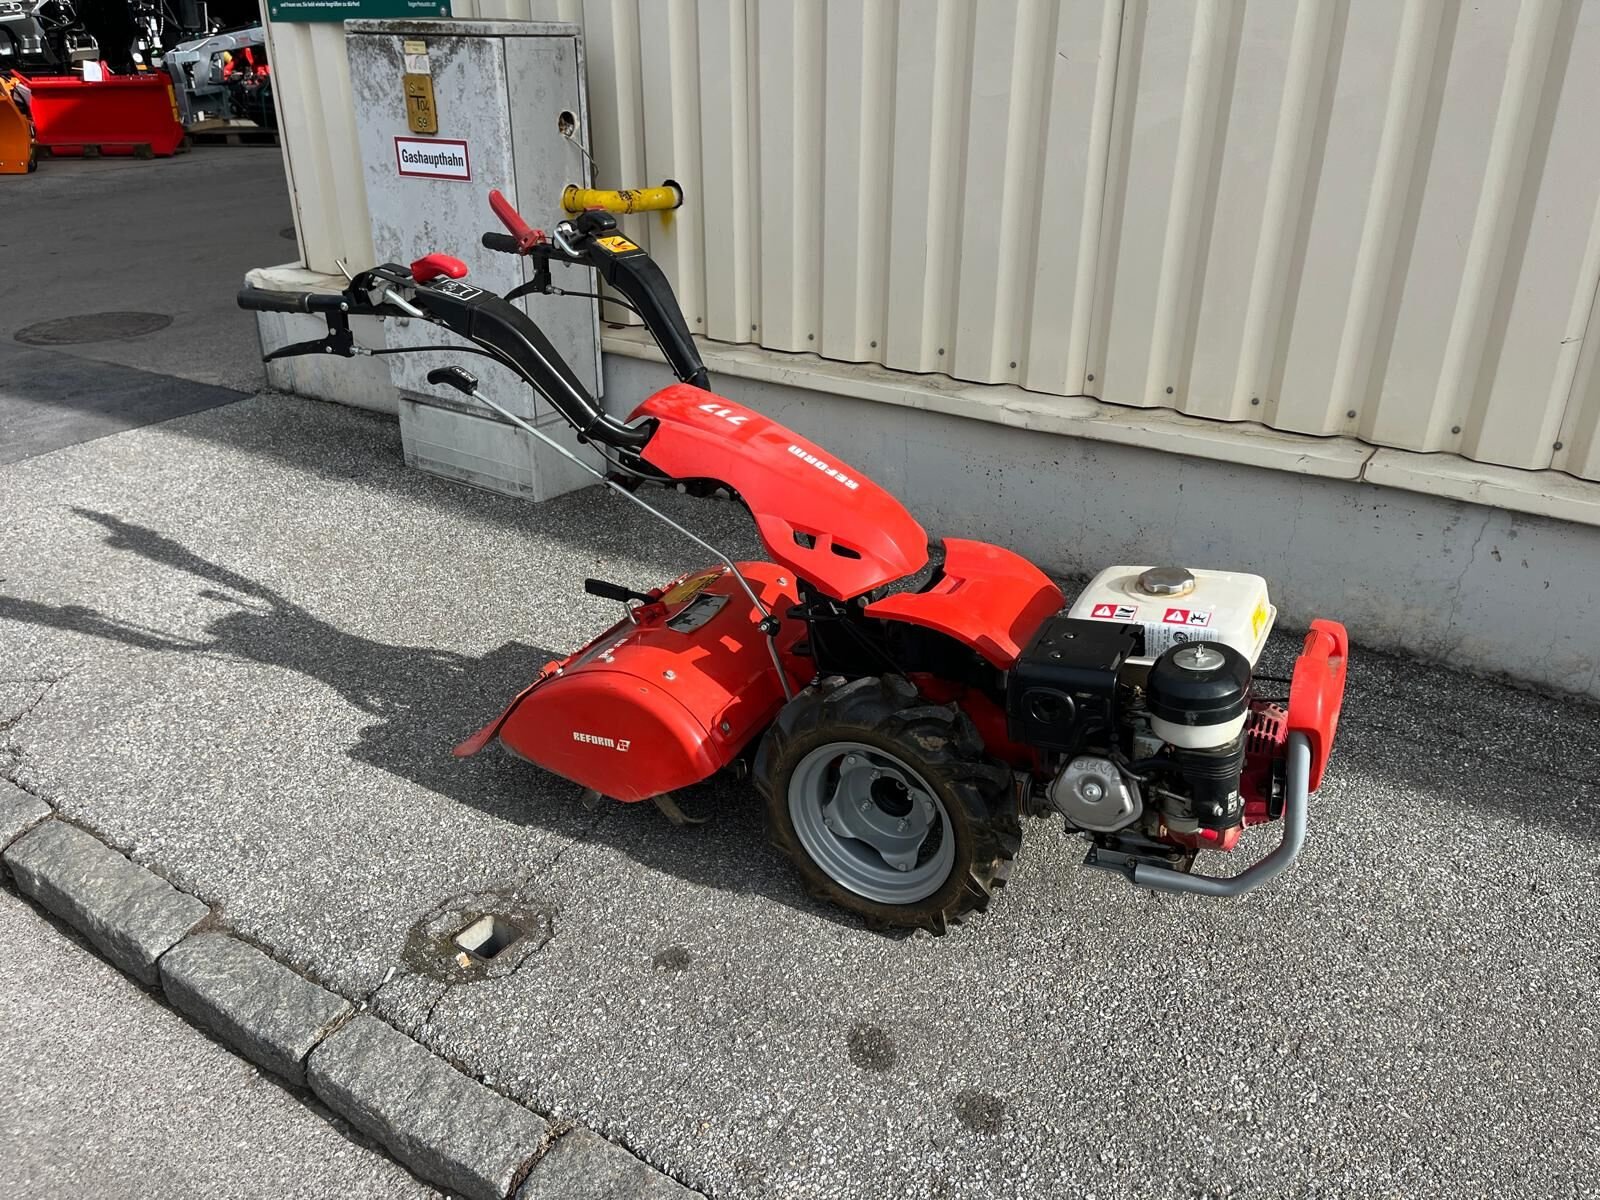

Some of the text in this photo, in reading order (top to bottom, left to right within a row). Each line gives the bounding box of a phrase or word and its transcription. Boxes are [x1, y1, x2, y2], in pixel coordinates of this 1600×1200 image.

[401, 148, 464, 168] Gashaupthahn
[698, 403, 749, 425] 717
[787, 444, 860, 490] REFORM
[572, 731, 615, 748] REFORM
